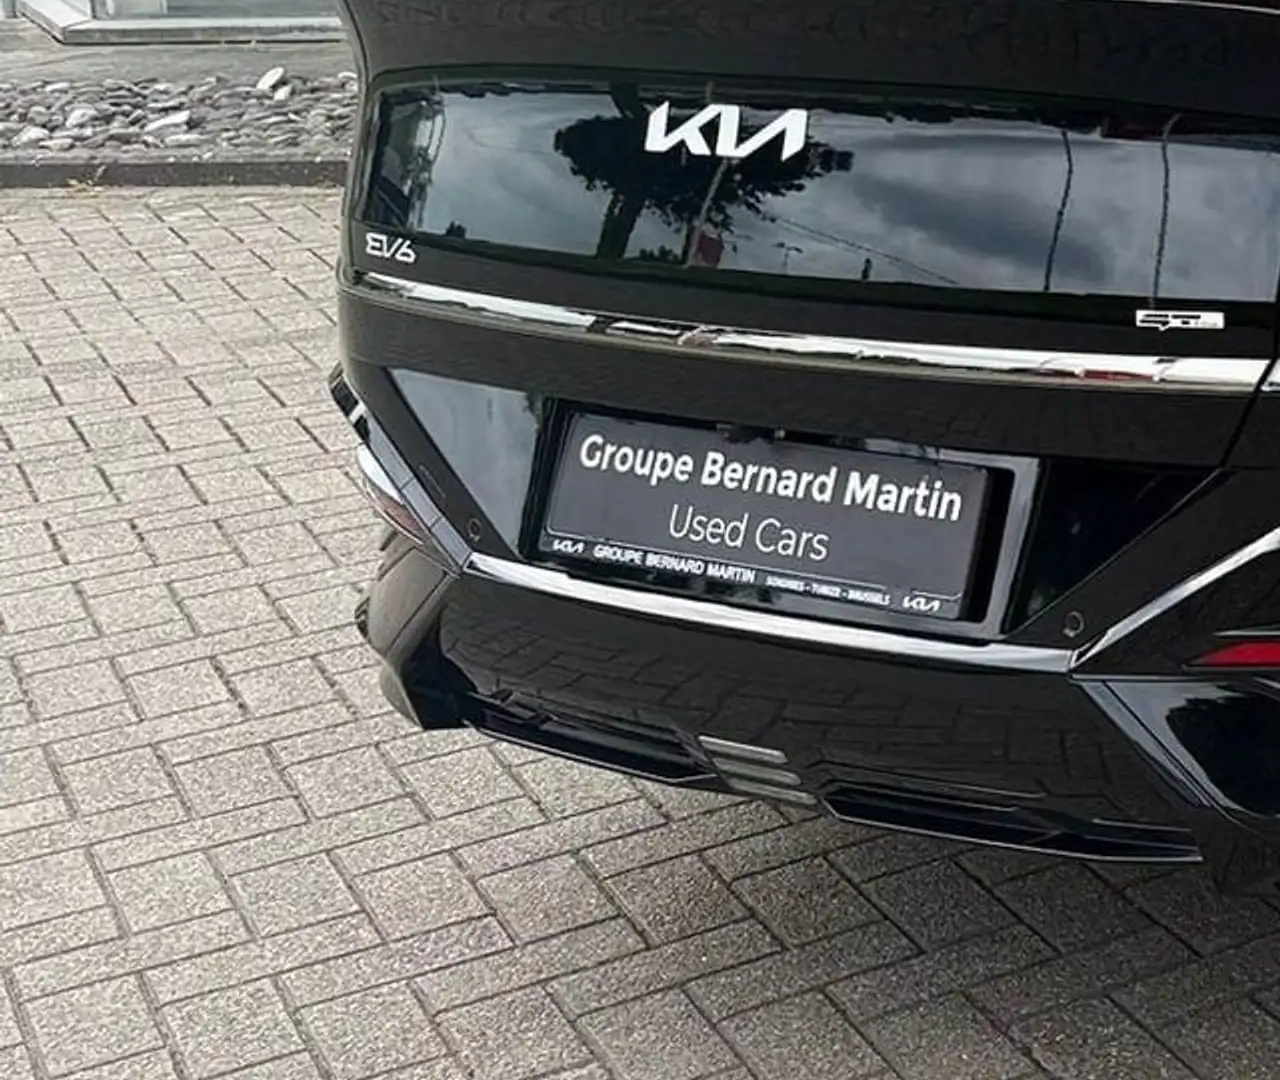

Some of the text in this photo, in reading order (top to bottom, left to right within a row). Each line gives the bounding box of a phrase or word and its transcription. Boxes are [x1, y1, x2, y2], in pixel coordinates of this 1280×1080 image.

[644, 100, 808, 162] KIA
[366, 232, 416, 264] EV6
[579, 433, 963, 522] Groupe Bernard Martin
[668, 503, 831, 563] Used Cars
[593, 544, 643, 566] GROUPE
[646, 552, 705, 576] BERNARD
[706, 563, 755, 584] MARTIN
